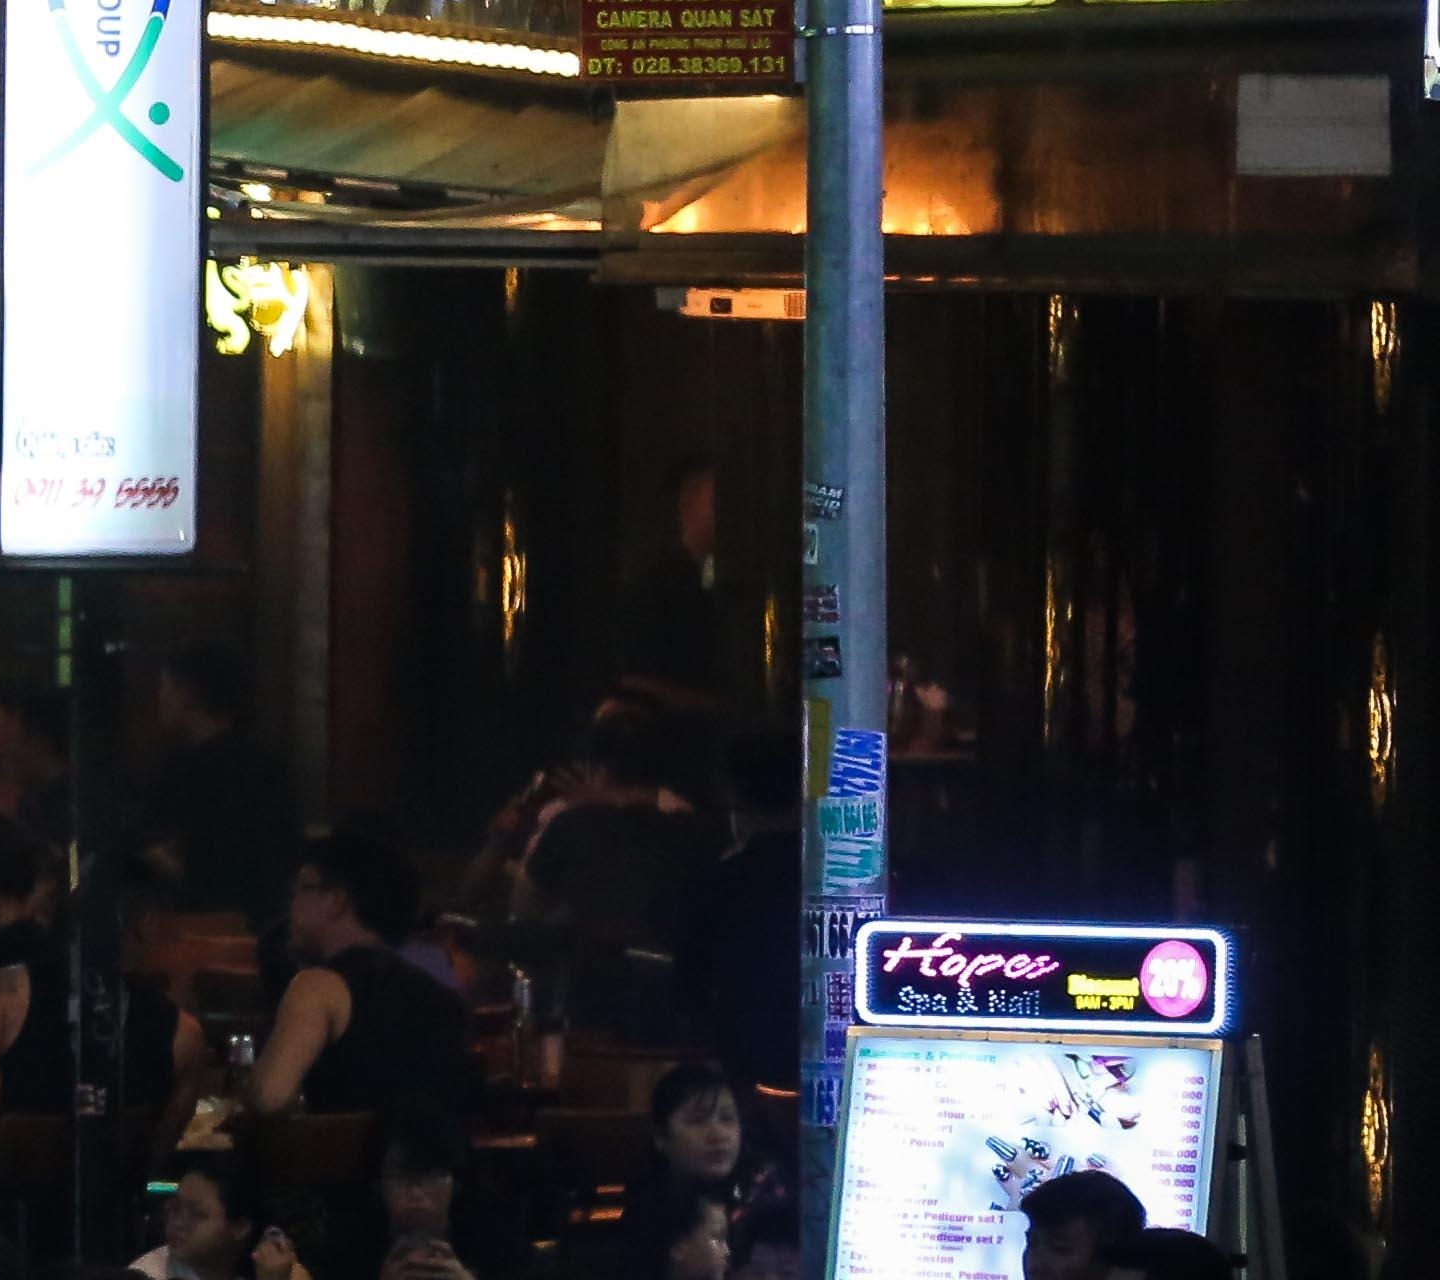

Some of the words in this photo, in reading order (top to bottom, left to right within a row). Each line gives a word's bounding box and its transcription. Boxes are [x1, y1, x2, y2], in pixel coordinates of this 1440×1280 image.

[596, 8, 673, 29] CAMERA
[679, 8, 733, 29] QUAN
[896, 985, 948, 1016] Spa
[956, 987, 979, 1013] &
[987, 989, 1041, 1016] Nail
